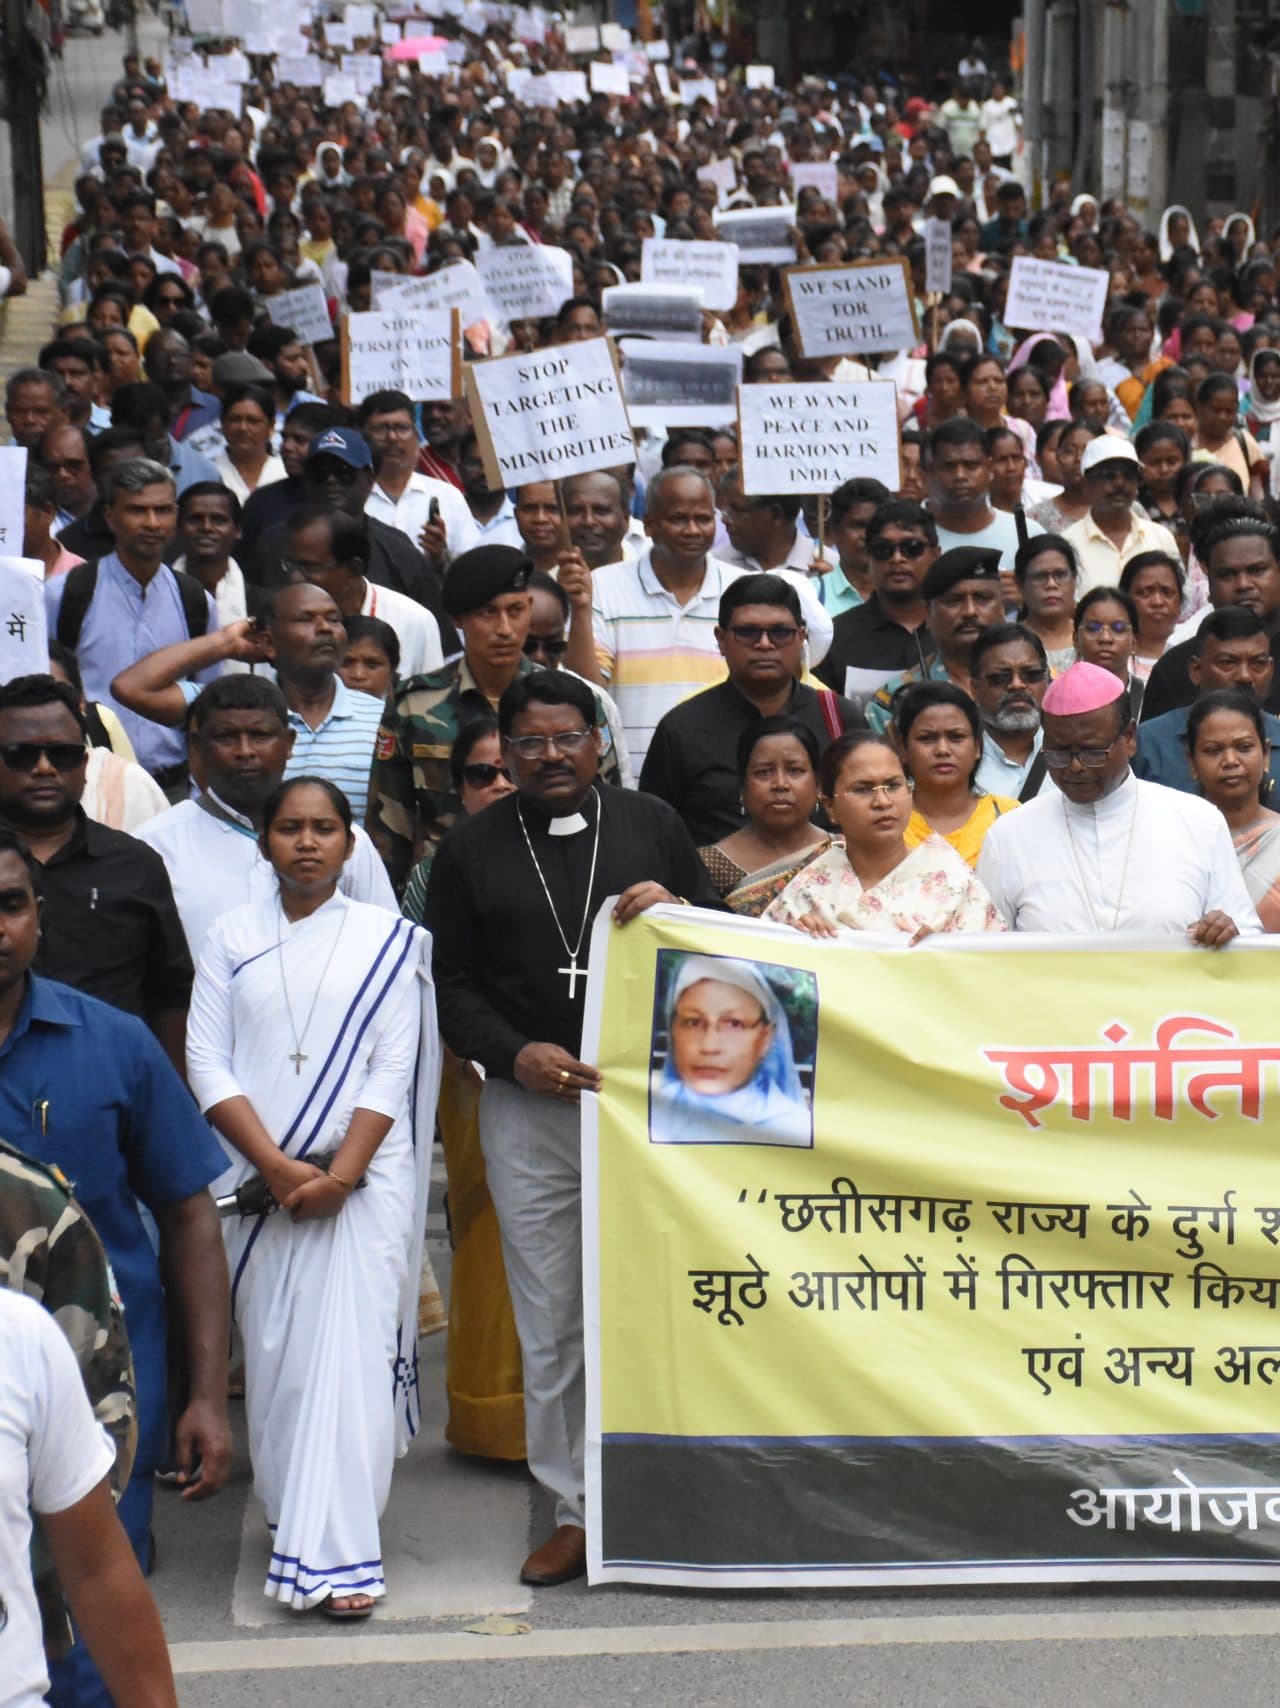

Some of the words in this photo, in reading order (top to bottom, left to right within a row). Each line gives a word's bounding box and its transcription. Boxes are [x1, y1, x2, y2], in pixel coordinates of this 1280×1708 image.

[799, 280, 827, 294] WE
[831, 275, 892, 293] STAND
[832, 301, 869, 318] FOR
[518, 359, 570, 384] STOP
[488, 377, 614, 418] TARGETING
[769, 394, 800, 409] WE
[804, 394, 860, 410] WANT
[535, 413, 579, 437] THE
[763, 418, 824, 434] PEACE
[831, 418, 870, 432] AND
[499, 431, 633, 473] MINIORITIES
[755, 442, 852, 459] HARMONY
[858, 442, 878, 457] IN
[986, 1201, 1089, 1239] राज्य
[1107, 1194, 1151, 1241] के
[1168, 1191, 1236, 1260] दुर्ग
[688, 1254, 769, 1326] झूठे
[788, 1254, 926, 1310] आरोपों
[943, 1255, 978, 1310] में
[996, 1254, 1174, 1309] गिरफ्तार
[1022, 1334, 1084, 1395] एवं
[1104, 1347, 1194, 1386] अन्य
